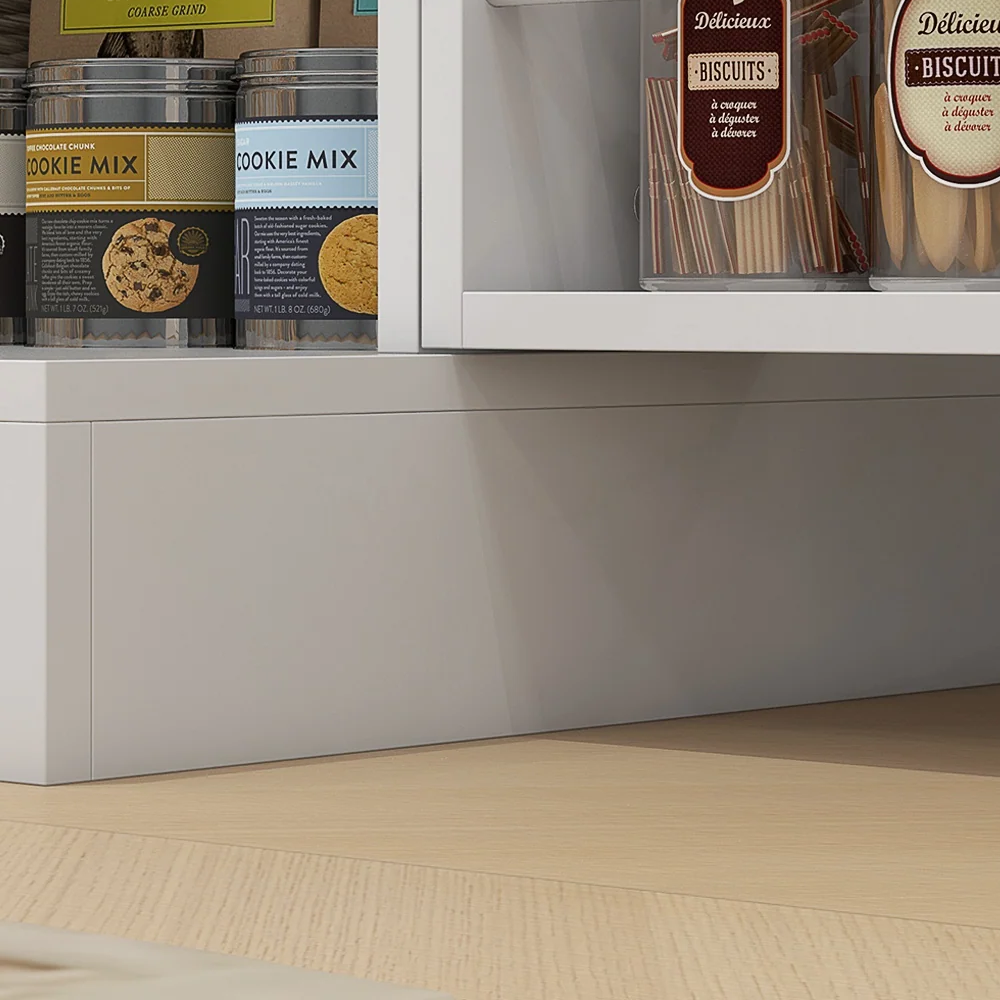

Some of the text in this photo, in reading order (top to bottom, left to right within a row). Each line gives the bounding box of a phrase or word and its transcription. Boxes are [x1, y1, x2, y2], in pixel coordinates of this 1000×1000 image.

[127, 4, 207, 18] COARSE GRIND
[694, 11, 772, 30] Délicieux
[700, 60, 765, 82] BISCUITS
[944, 92, 992, 104] à croquer
[711, 99, 757, 112] à croquer
[709, 112, 760, 126] à déguster
[942, 106, 995, 120] à déguster
[712, 126, 757, 138] à dévorer
[944, 120, 992, 132] à dévorer
[68, 142, 96, 150] CHUNK
[90, 156, 138, 174] MIX
[236, 150, 358, 171] COOKIE MIX
